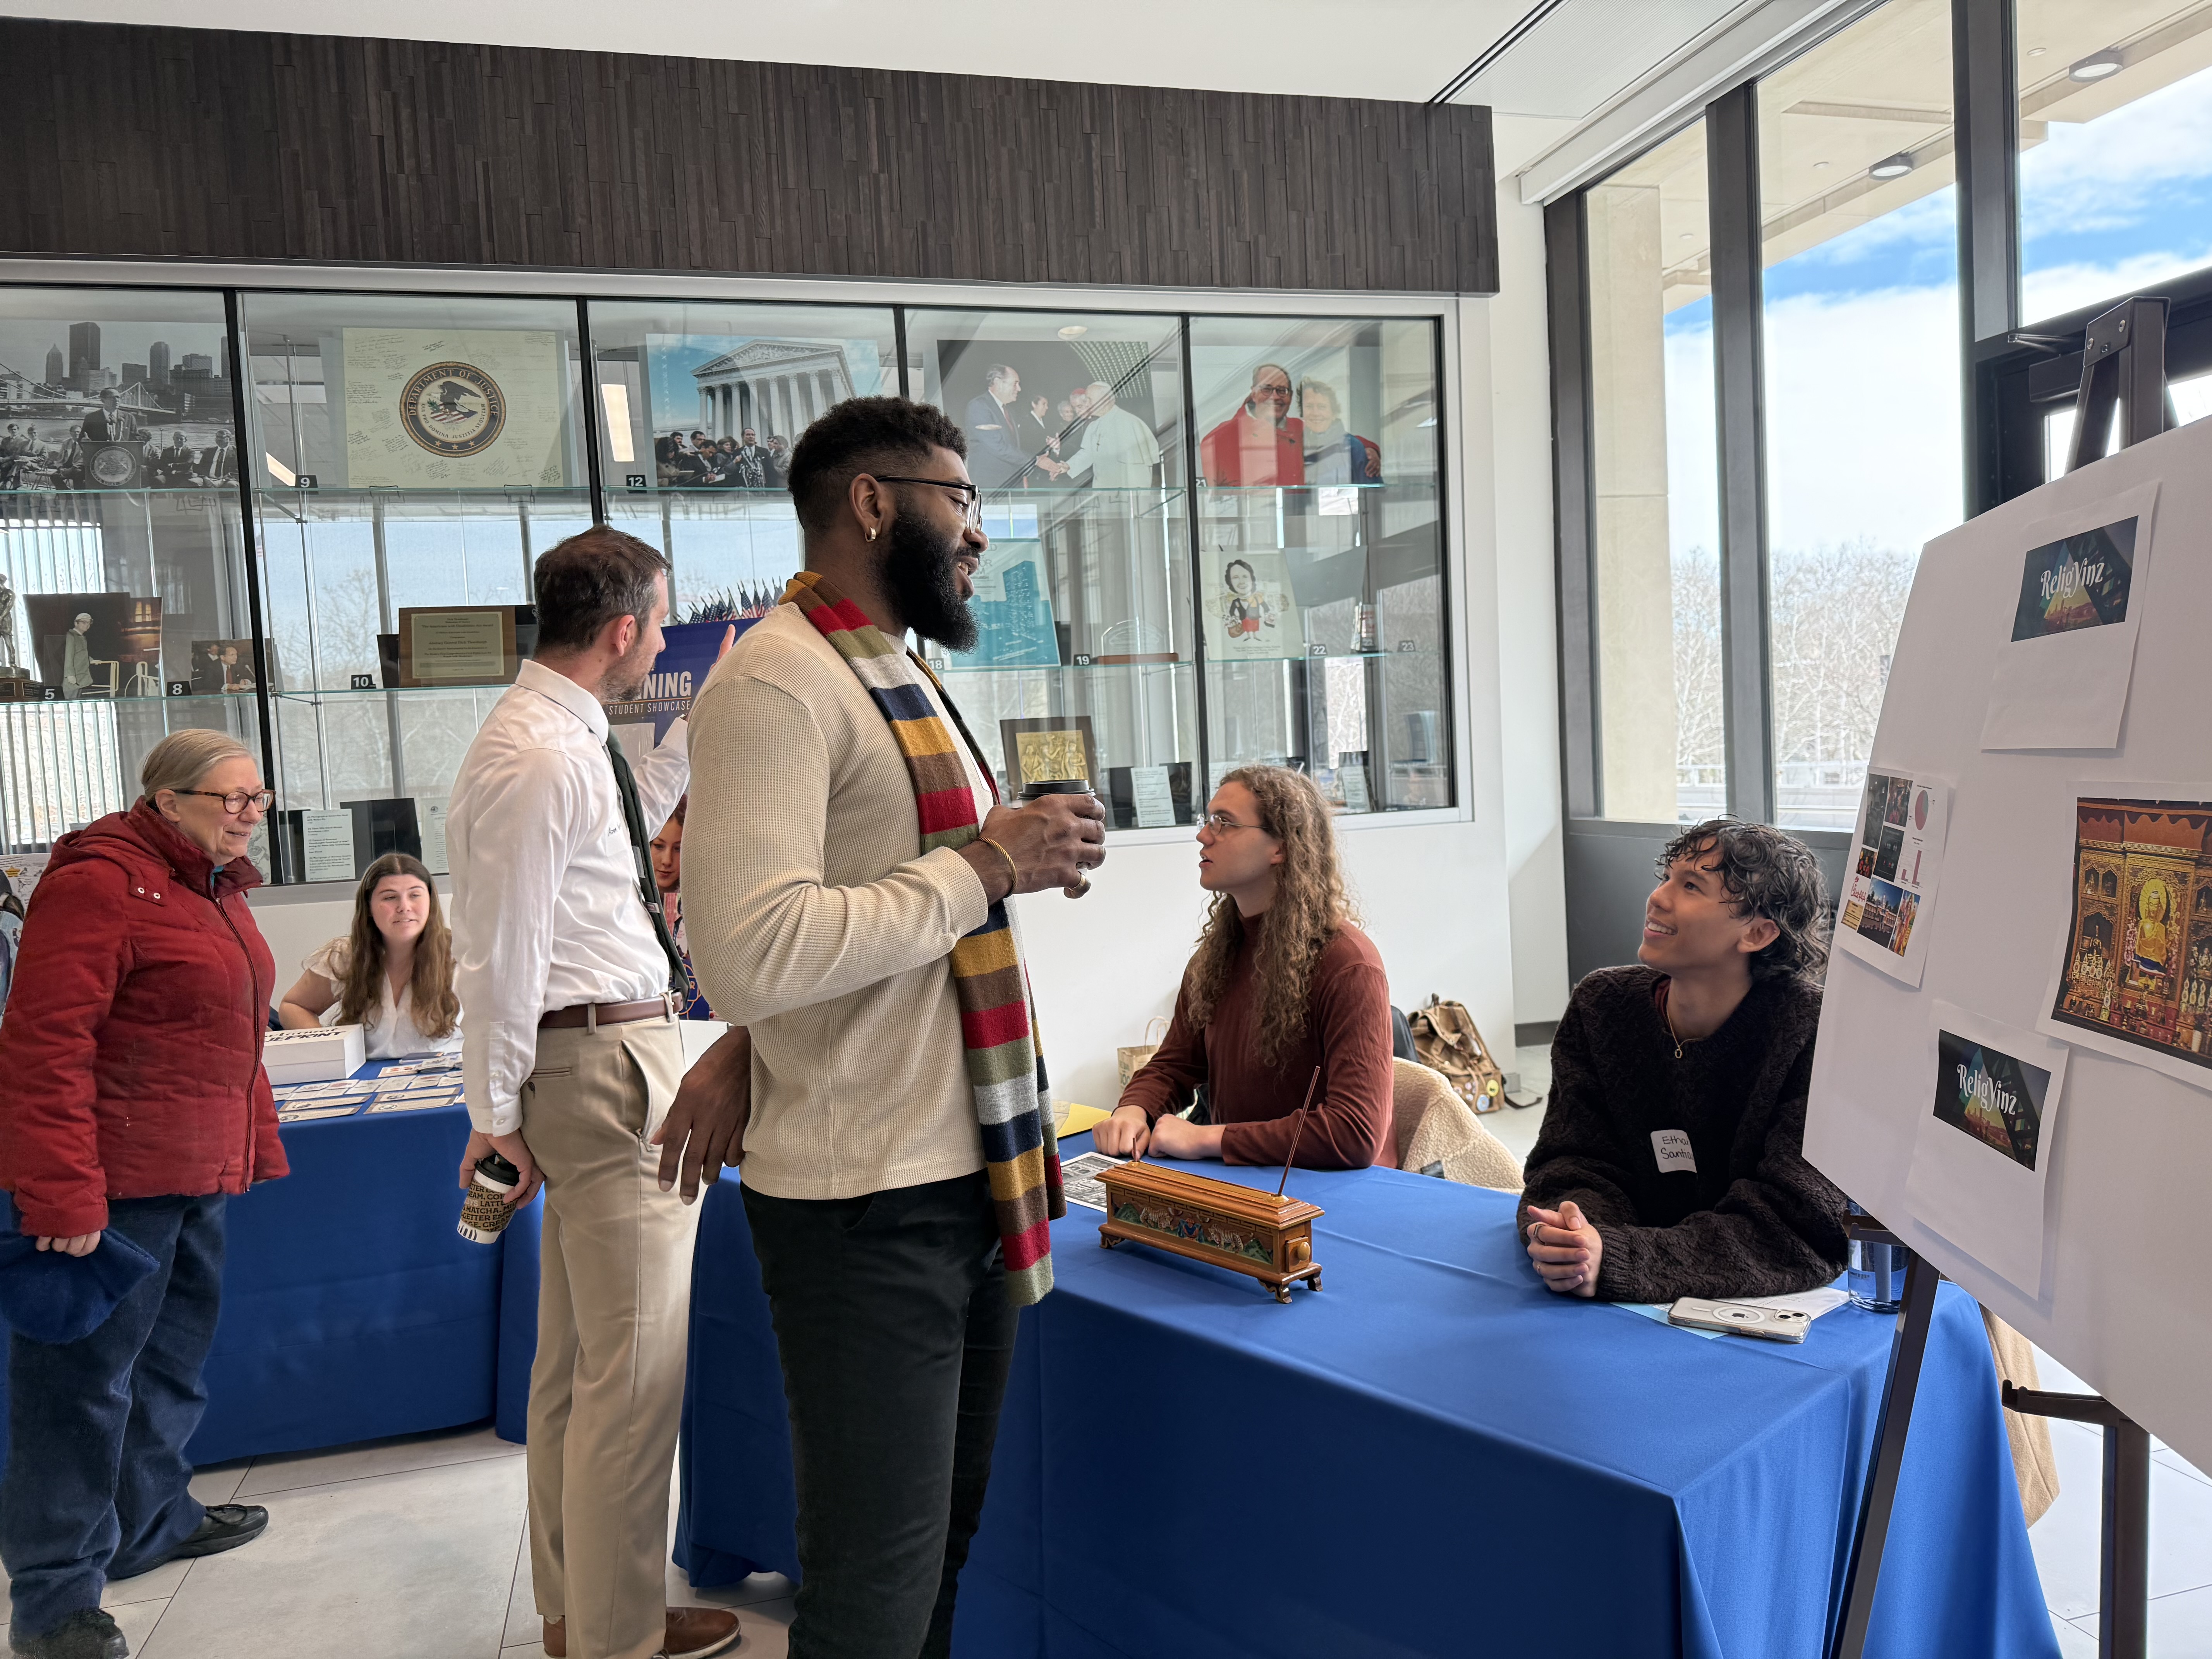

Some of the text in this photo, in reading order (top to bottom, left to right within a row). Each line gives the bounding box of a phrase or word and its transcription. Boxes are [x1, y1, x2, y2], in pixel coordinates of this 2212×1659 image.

[409, 369, 453, 416] DEPARTMENT
[459, 371, 472, 379] OF
[475, 379, 498, 416] JUSTICE
[428, 424, 449, 438] DOMINA
[452, 429, 476, 439] JUSTITIA
[476, 404, 486, 429] SEQUITUR
[300, 477, 310, 488] 9
[628, 477, 643, 487] 12
[1196, 479, 1206, 488] 21
[2040, 557, 2105, 599] ReligYinz
[1313, 646, 1326, 655] 22
[1401, 642, 1414, 651] 23
[929, 659, 943, 670] 18
[1077, 656, 1089, 665] 19
[353, 677, 369, 687] 10
[642, 671, 692, 699] NING
[45, 689, 55, 700] 5
[172, 684, 182, 695] 8
[609, 700, 691, 715] STUDENT SHOWCASE
[1956, 1064, 2017, 1115] ReligYinz
[1662, 1135, 1689, 1145] Etha
